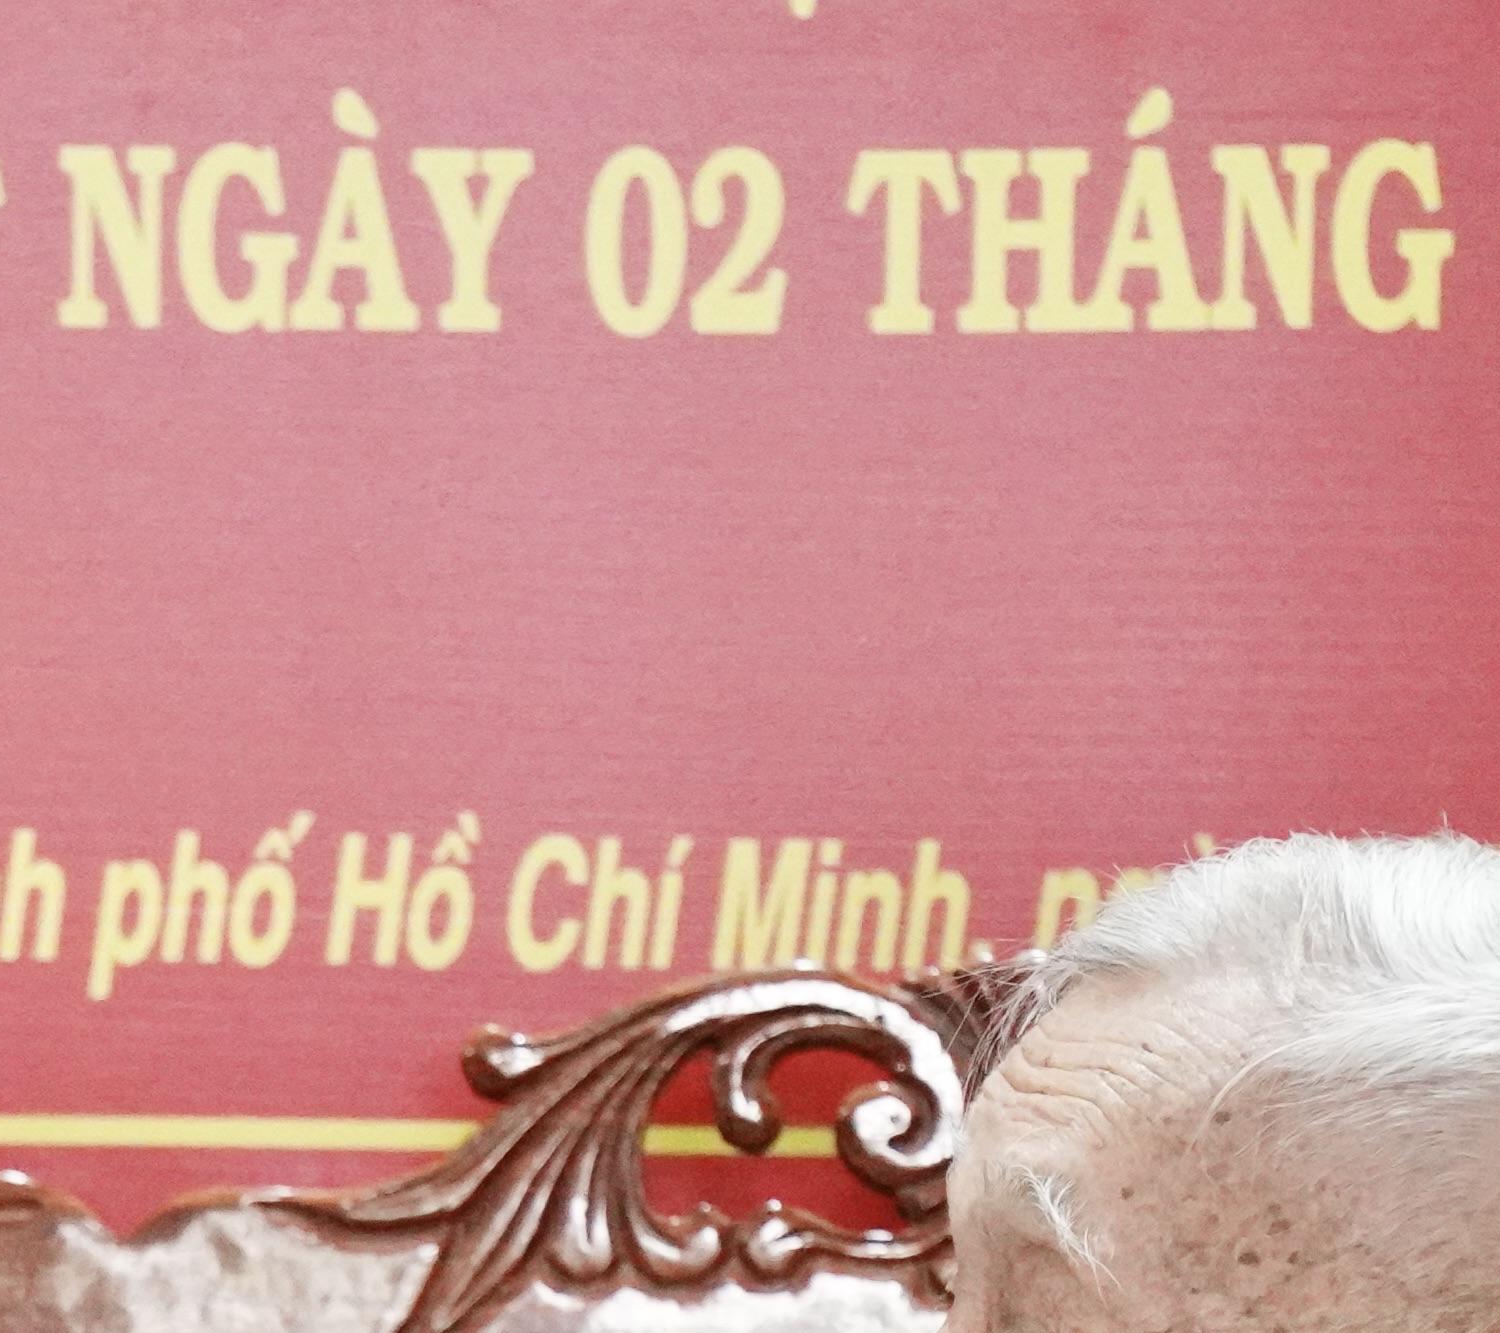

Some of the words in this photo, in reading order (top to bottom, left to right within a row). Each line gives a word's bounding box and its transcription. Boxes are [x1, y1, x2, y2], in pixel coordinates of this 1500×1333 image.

[57, 87, 535, 334] NGÀY
[584, 144, 788, 338] 02
[845, 86, 1456, 335] THÁNG
[87, 809, 313, 1002] phố
[326, 811, 480, 970] Hồ
[506, 833, 693, 972] Chí
